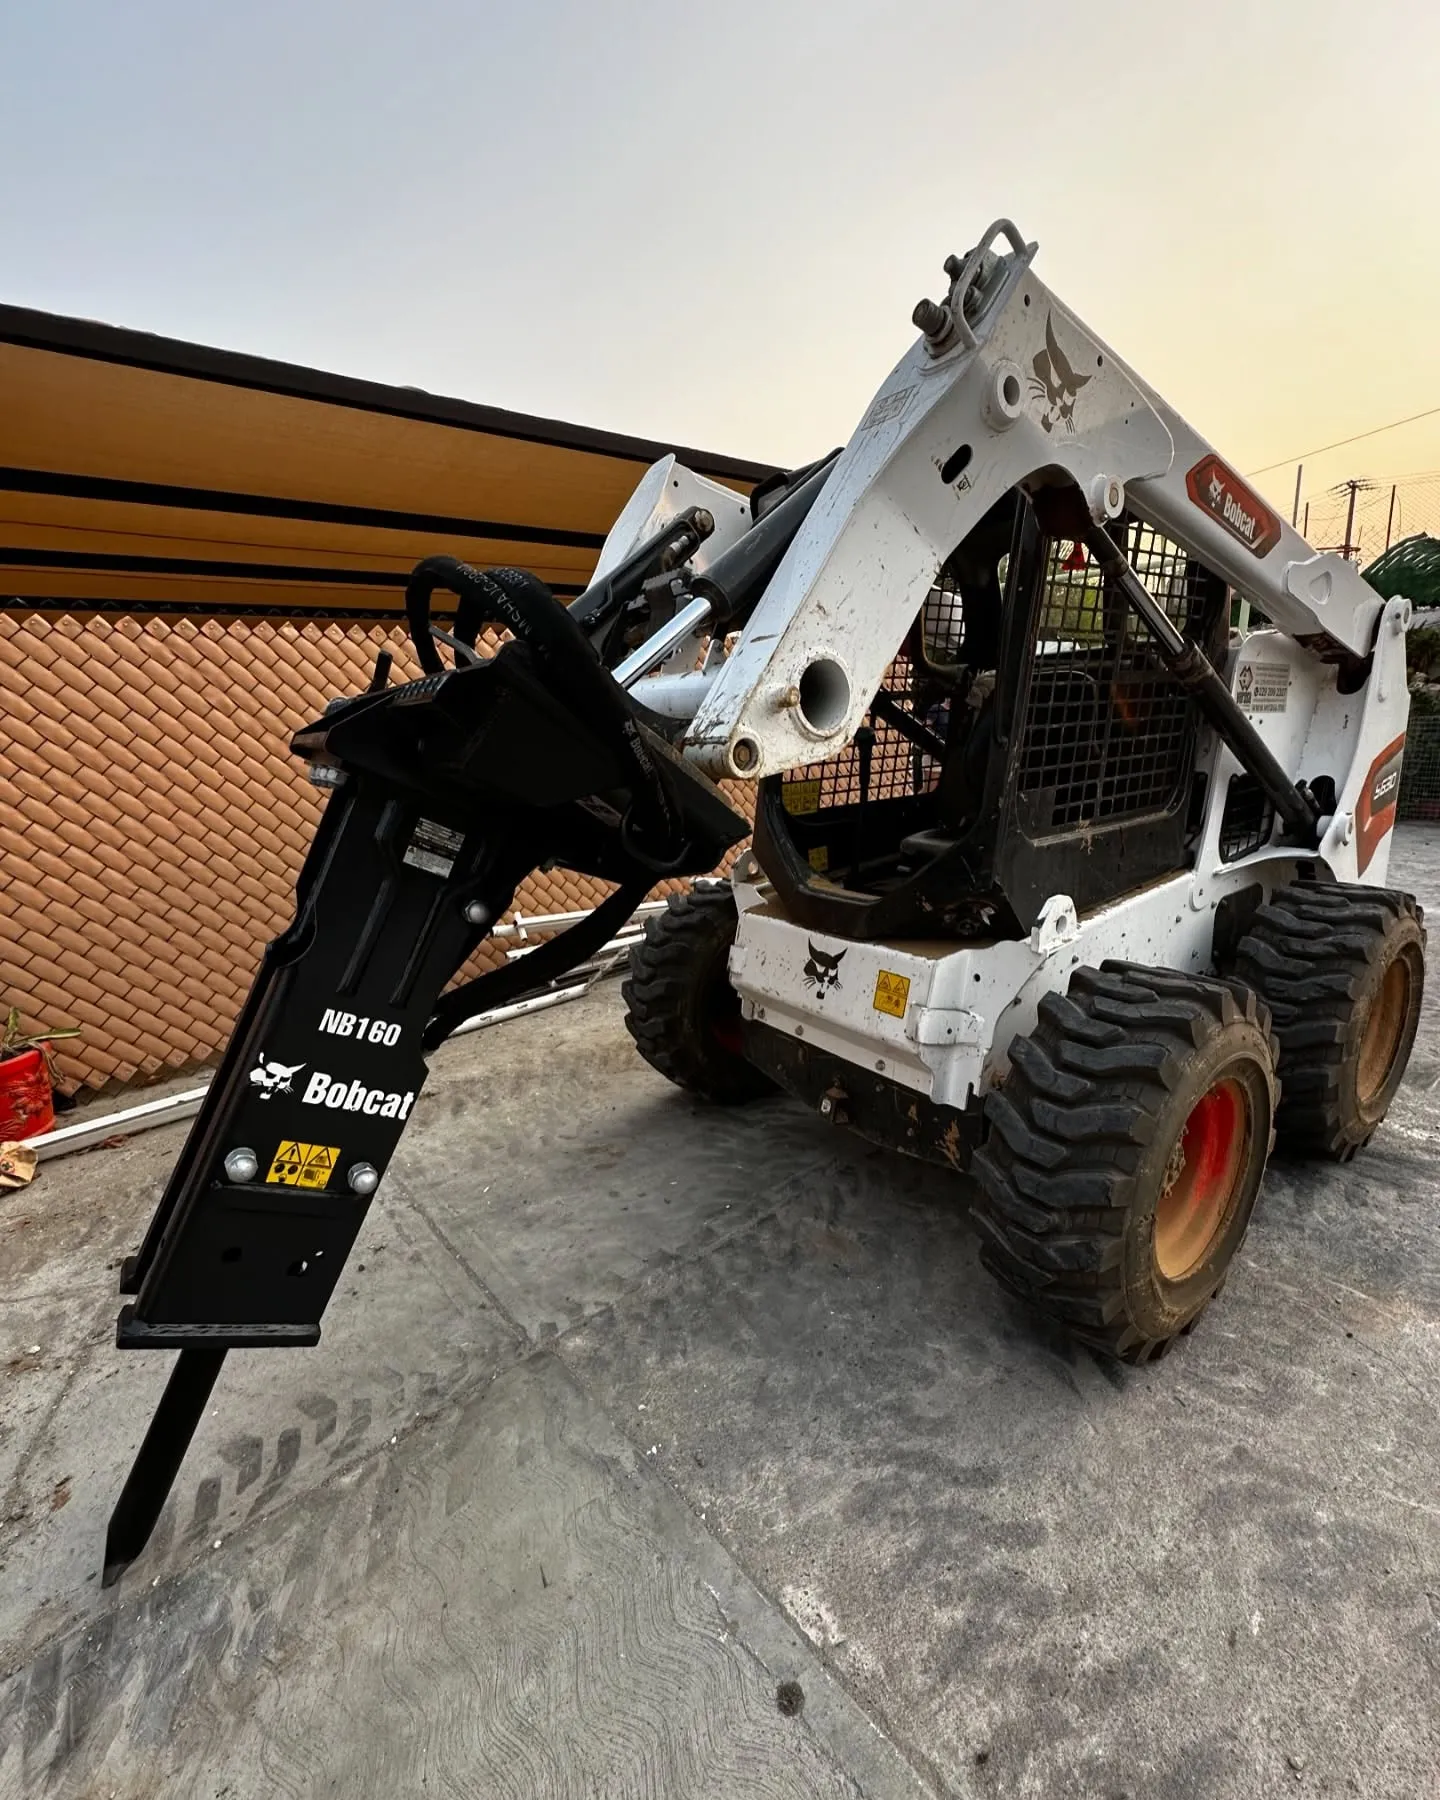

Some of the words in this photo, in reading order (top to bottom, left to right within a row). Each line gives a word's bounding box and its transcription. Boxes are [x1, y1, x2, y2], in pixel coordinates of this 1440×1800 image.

[1223, 492, 1256, 540] Bobcat
[318, 1008, 402, 1047] NB160
[302, 1071, 415, 1121] Bobcat
